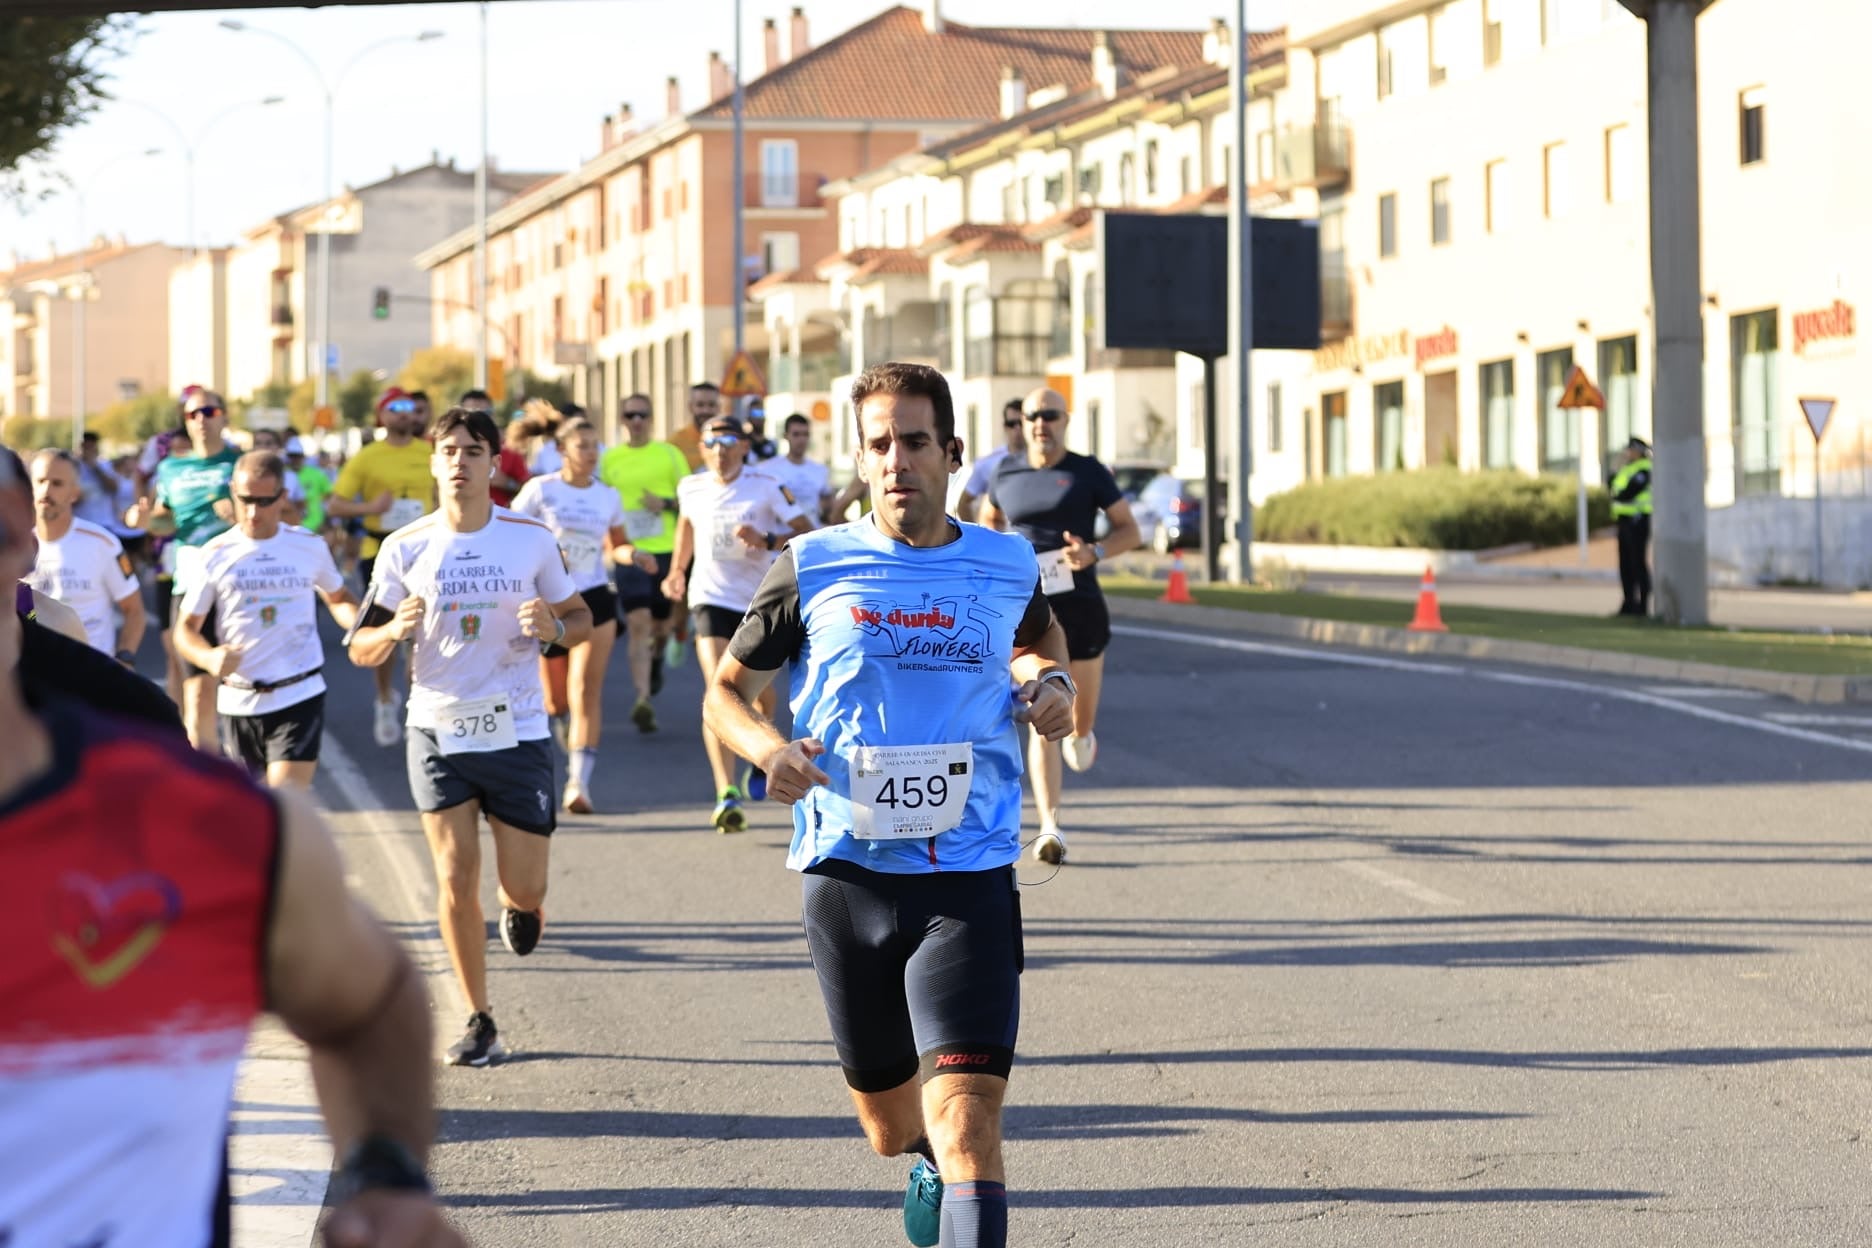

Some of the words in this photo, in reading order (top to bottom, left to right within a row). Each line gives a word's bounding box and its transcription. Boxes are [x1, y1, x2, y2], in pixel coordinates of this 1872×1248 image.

[449, 565, 505, 579] CARRERA
[903, 635, 981, 659] FLOWERS
[452, 713, 498, 738] 378
[875, 775, 948, 809] 459
[935, 1053, 992, 1069] HOKO
